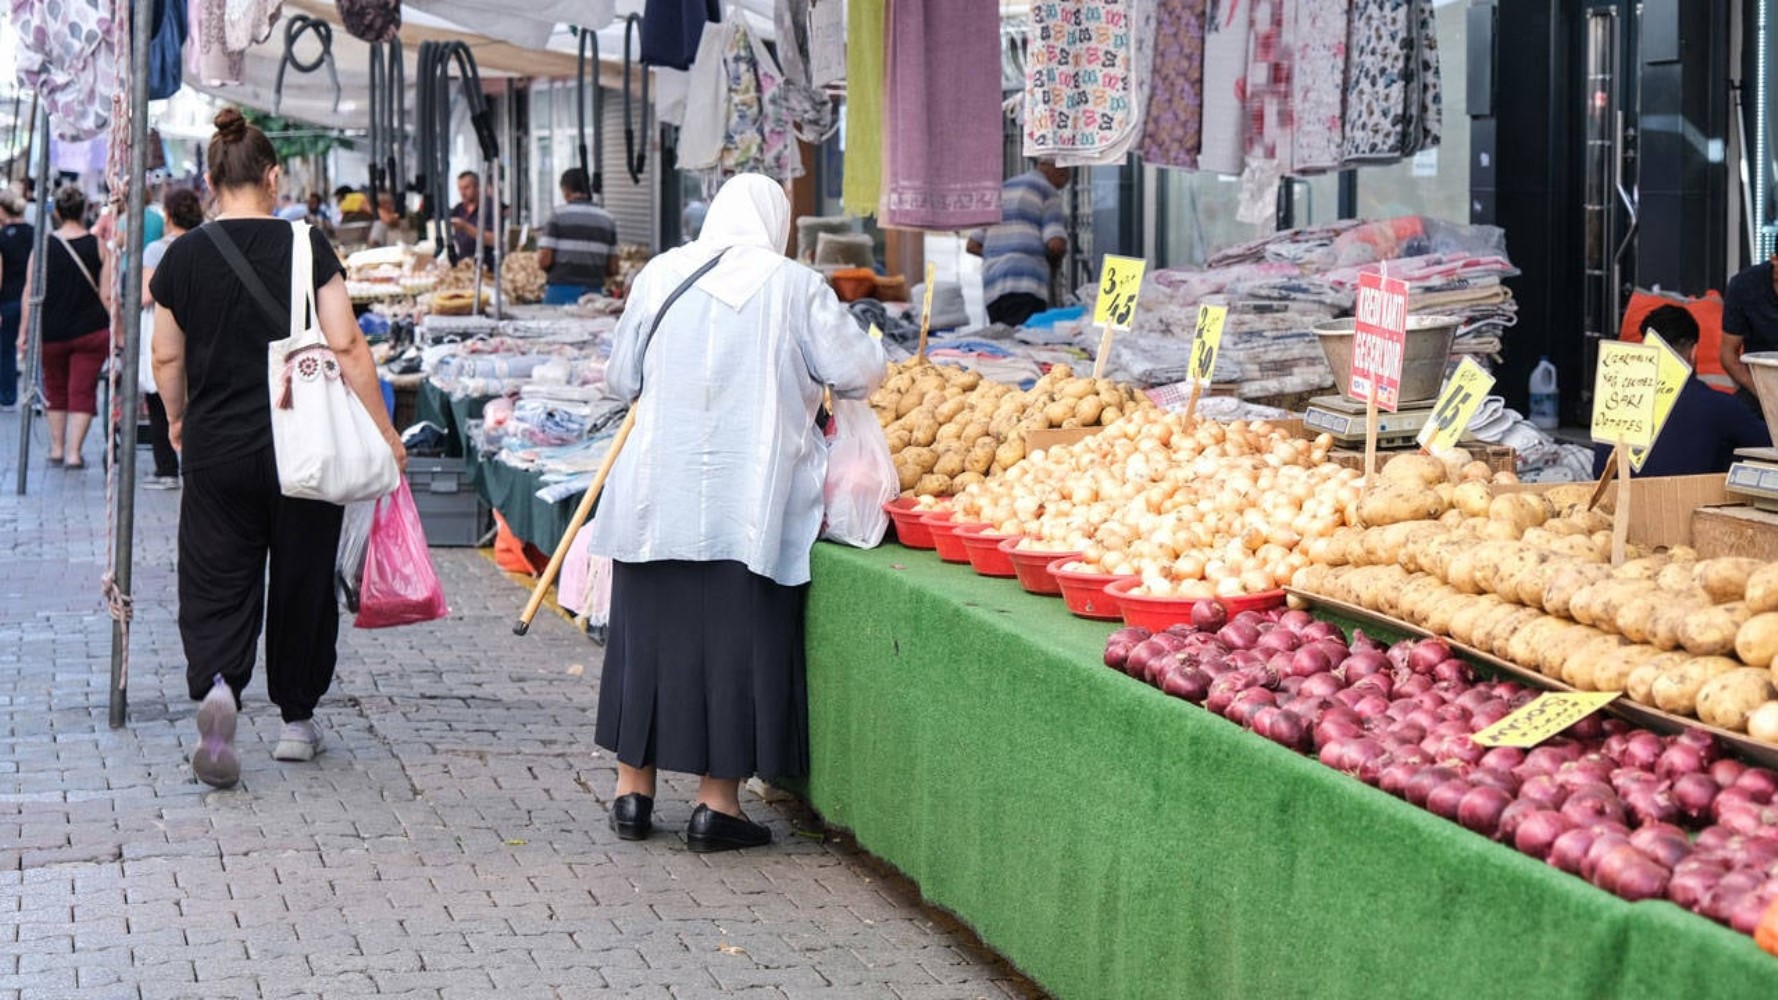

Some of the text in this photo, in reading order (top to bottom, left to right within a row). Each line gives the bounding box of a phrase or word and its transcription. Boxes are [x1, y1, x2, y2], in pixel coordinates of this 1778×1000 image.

[1103, 267, 1117, 295] 3
[1106, 293, 1136, 325] 45
[1435, 384, 1472, 430] 15
